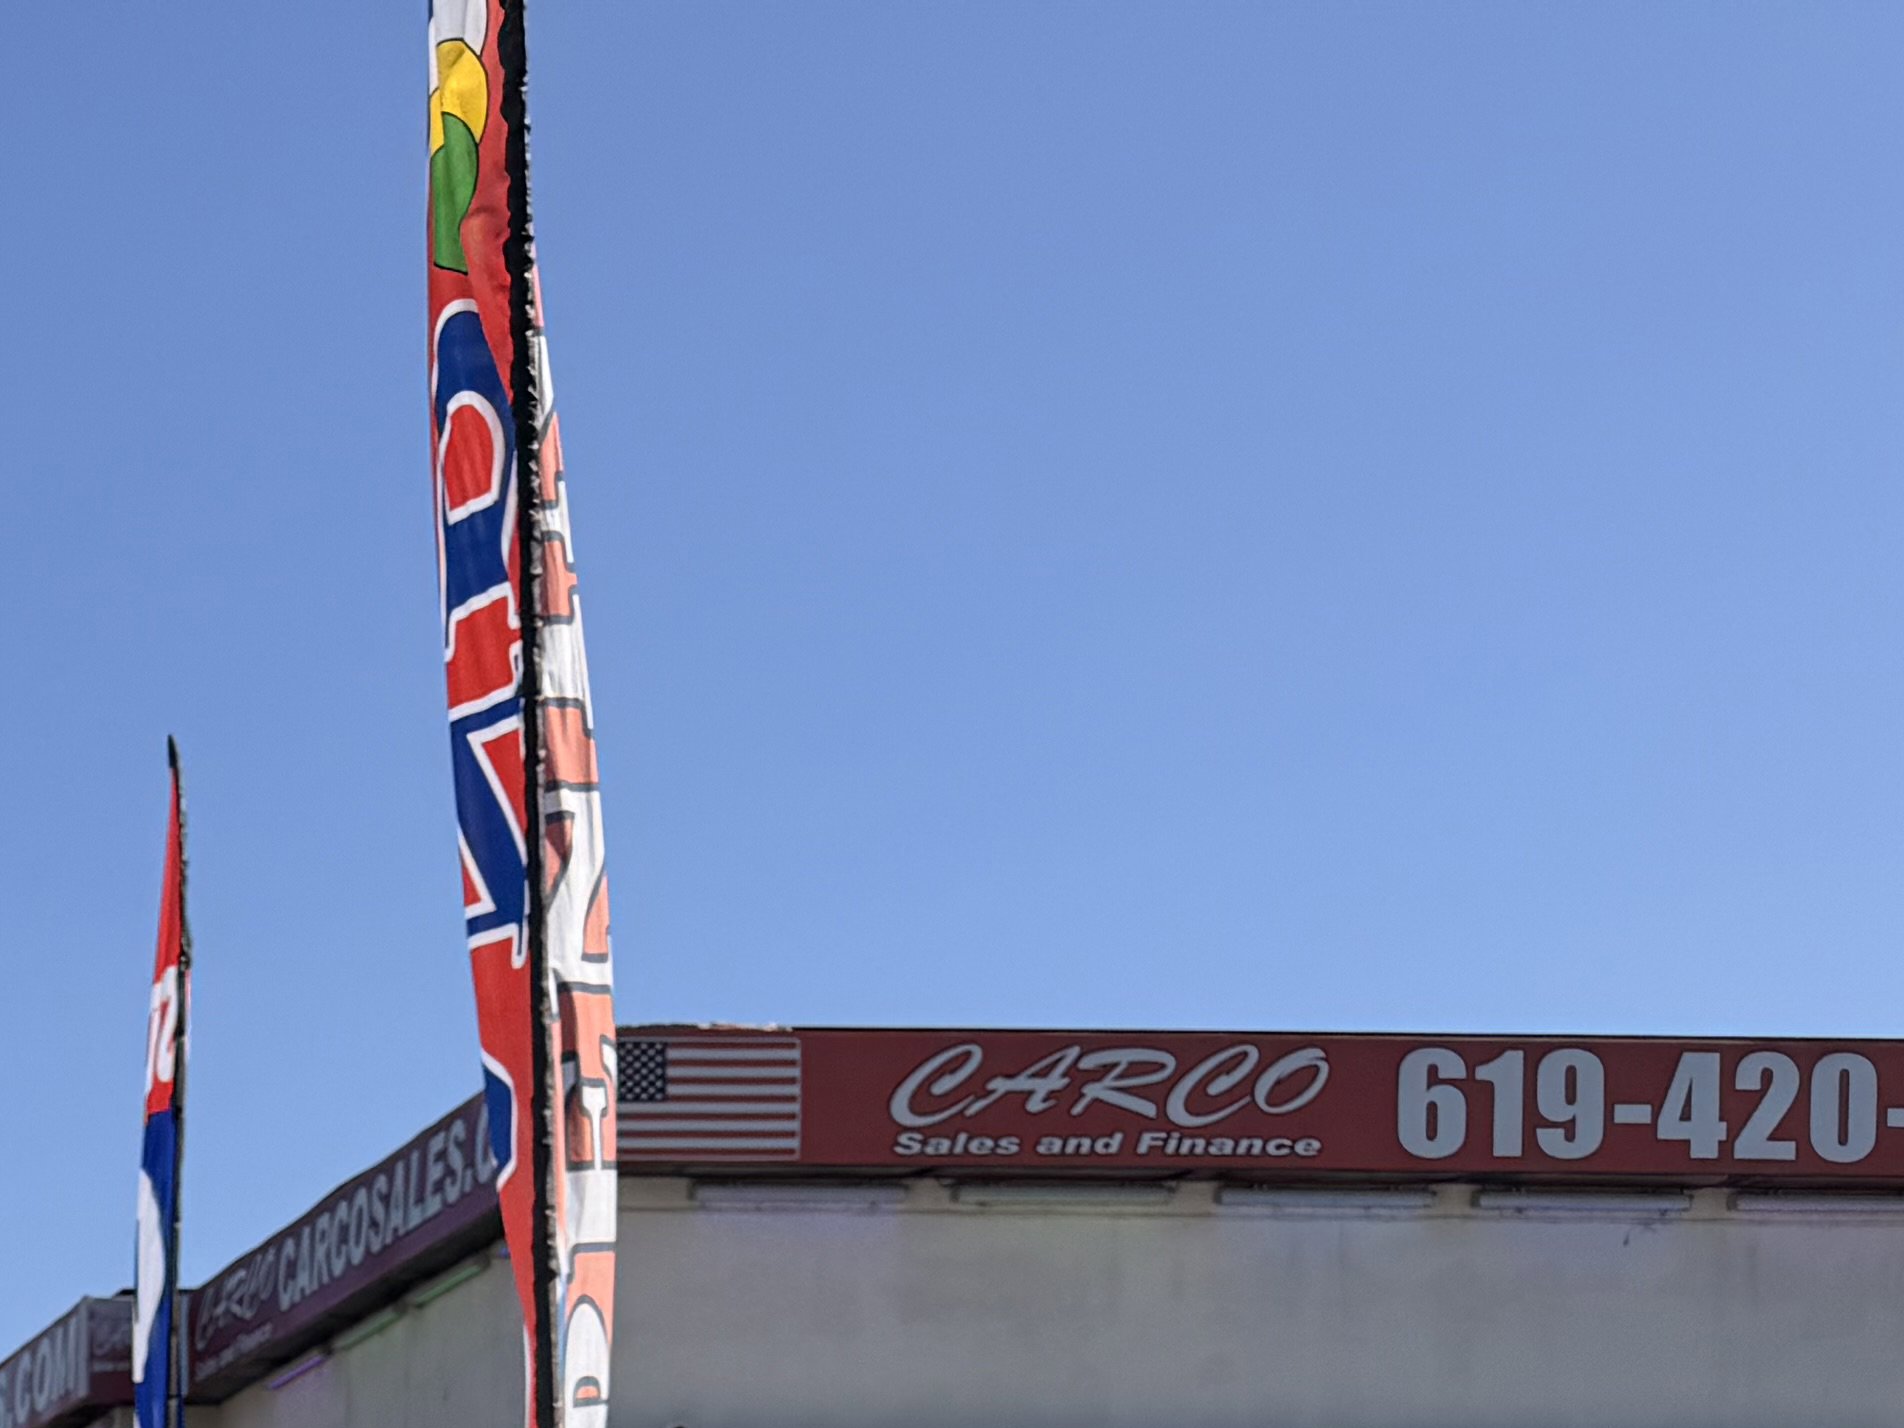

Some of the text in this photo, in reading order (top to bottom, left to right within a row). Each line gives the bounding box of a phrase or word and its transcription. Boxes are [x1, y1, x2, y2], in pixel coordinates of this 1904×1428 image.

[888, 1043, 1330, 1129] CARCO
[890, 1130, 1323, 1158] Sales and Finance
